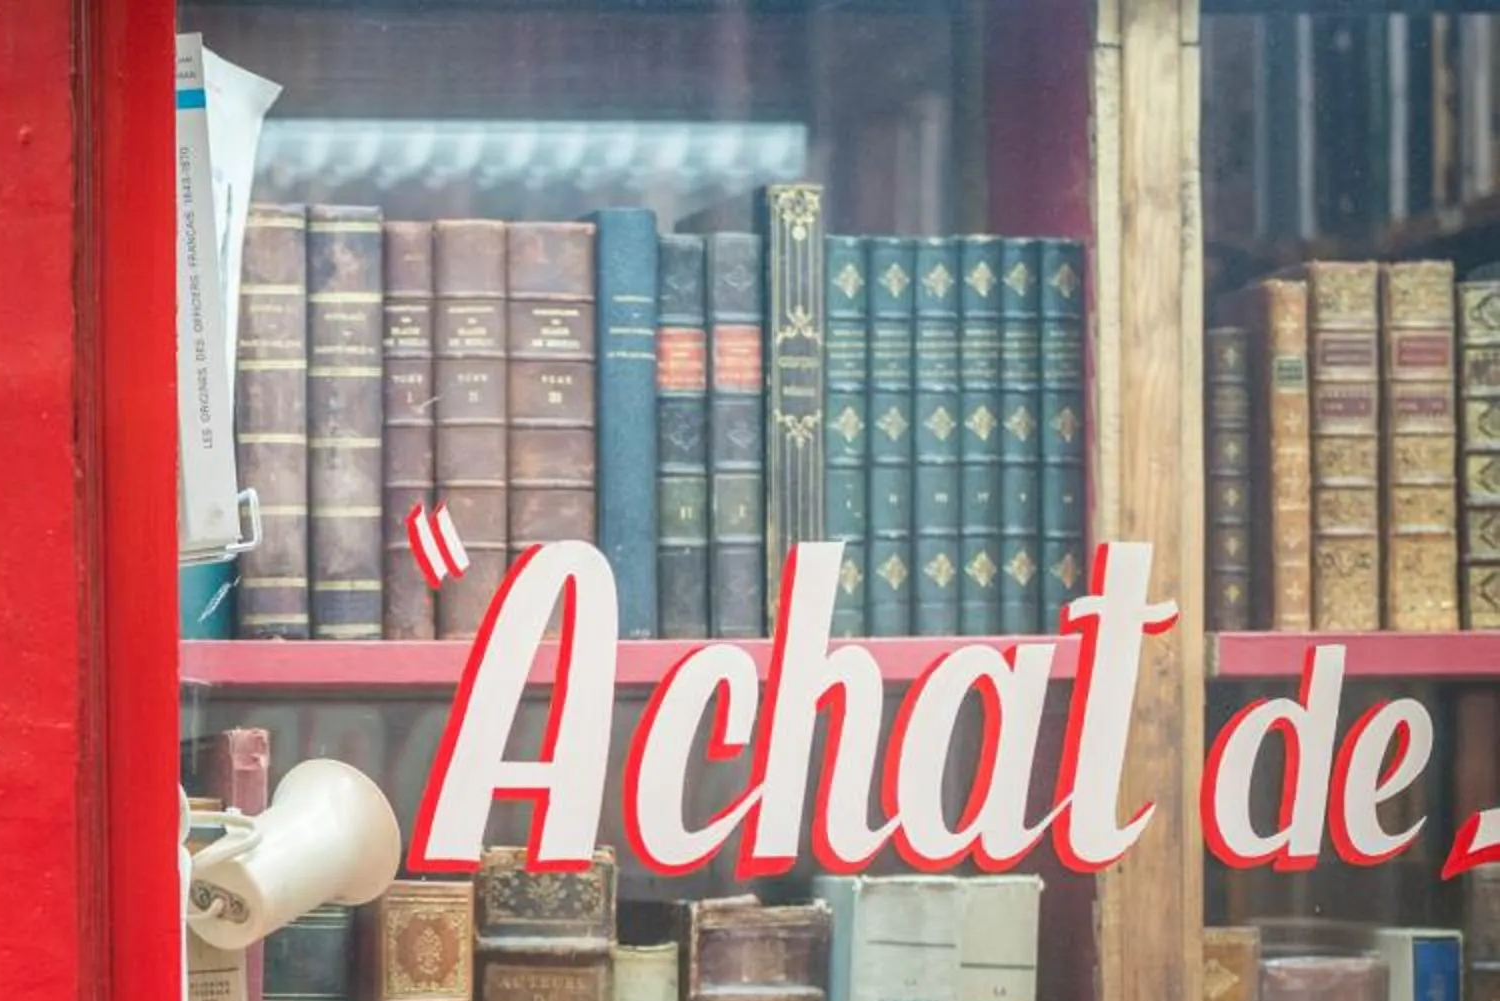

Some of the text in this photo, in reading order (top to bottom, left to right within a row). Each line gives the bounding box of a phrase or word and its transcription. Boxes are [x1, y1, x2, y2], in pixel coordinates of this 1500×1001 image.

[189, 274, 204, 333] OFFICIERS
[193, 339, 206, 361] DES
[196, 368, 211, 423] ORIGINES
[202, 429, 213, 449] LES
[1199, 643, 1437, 872] de
